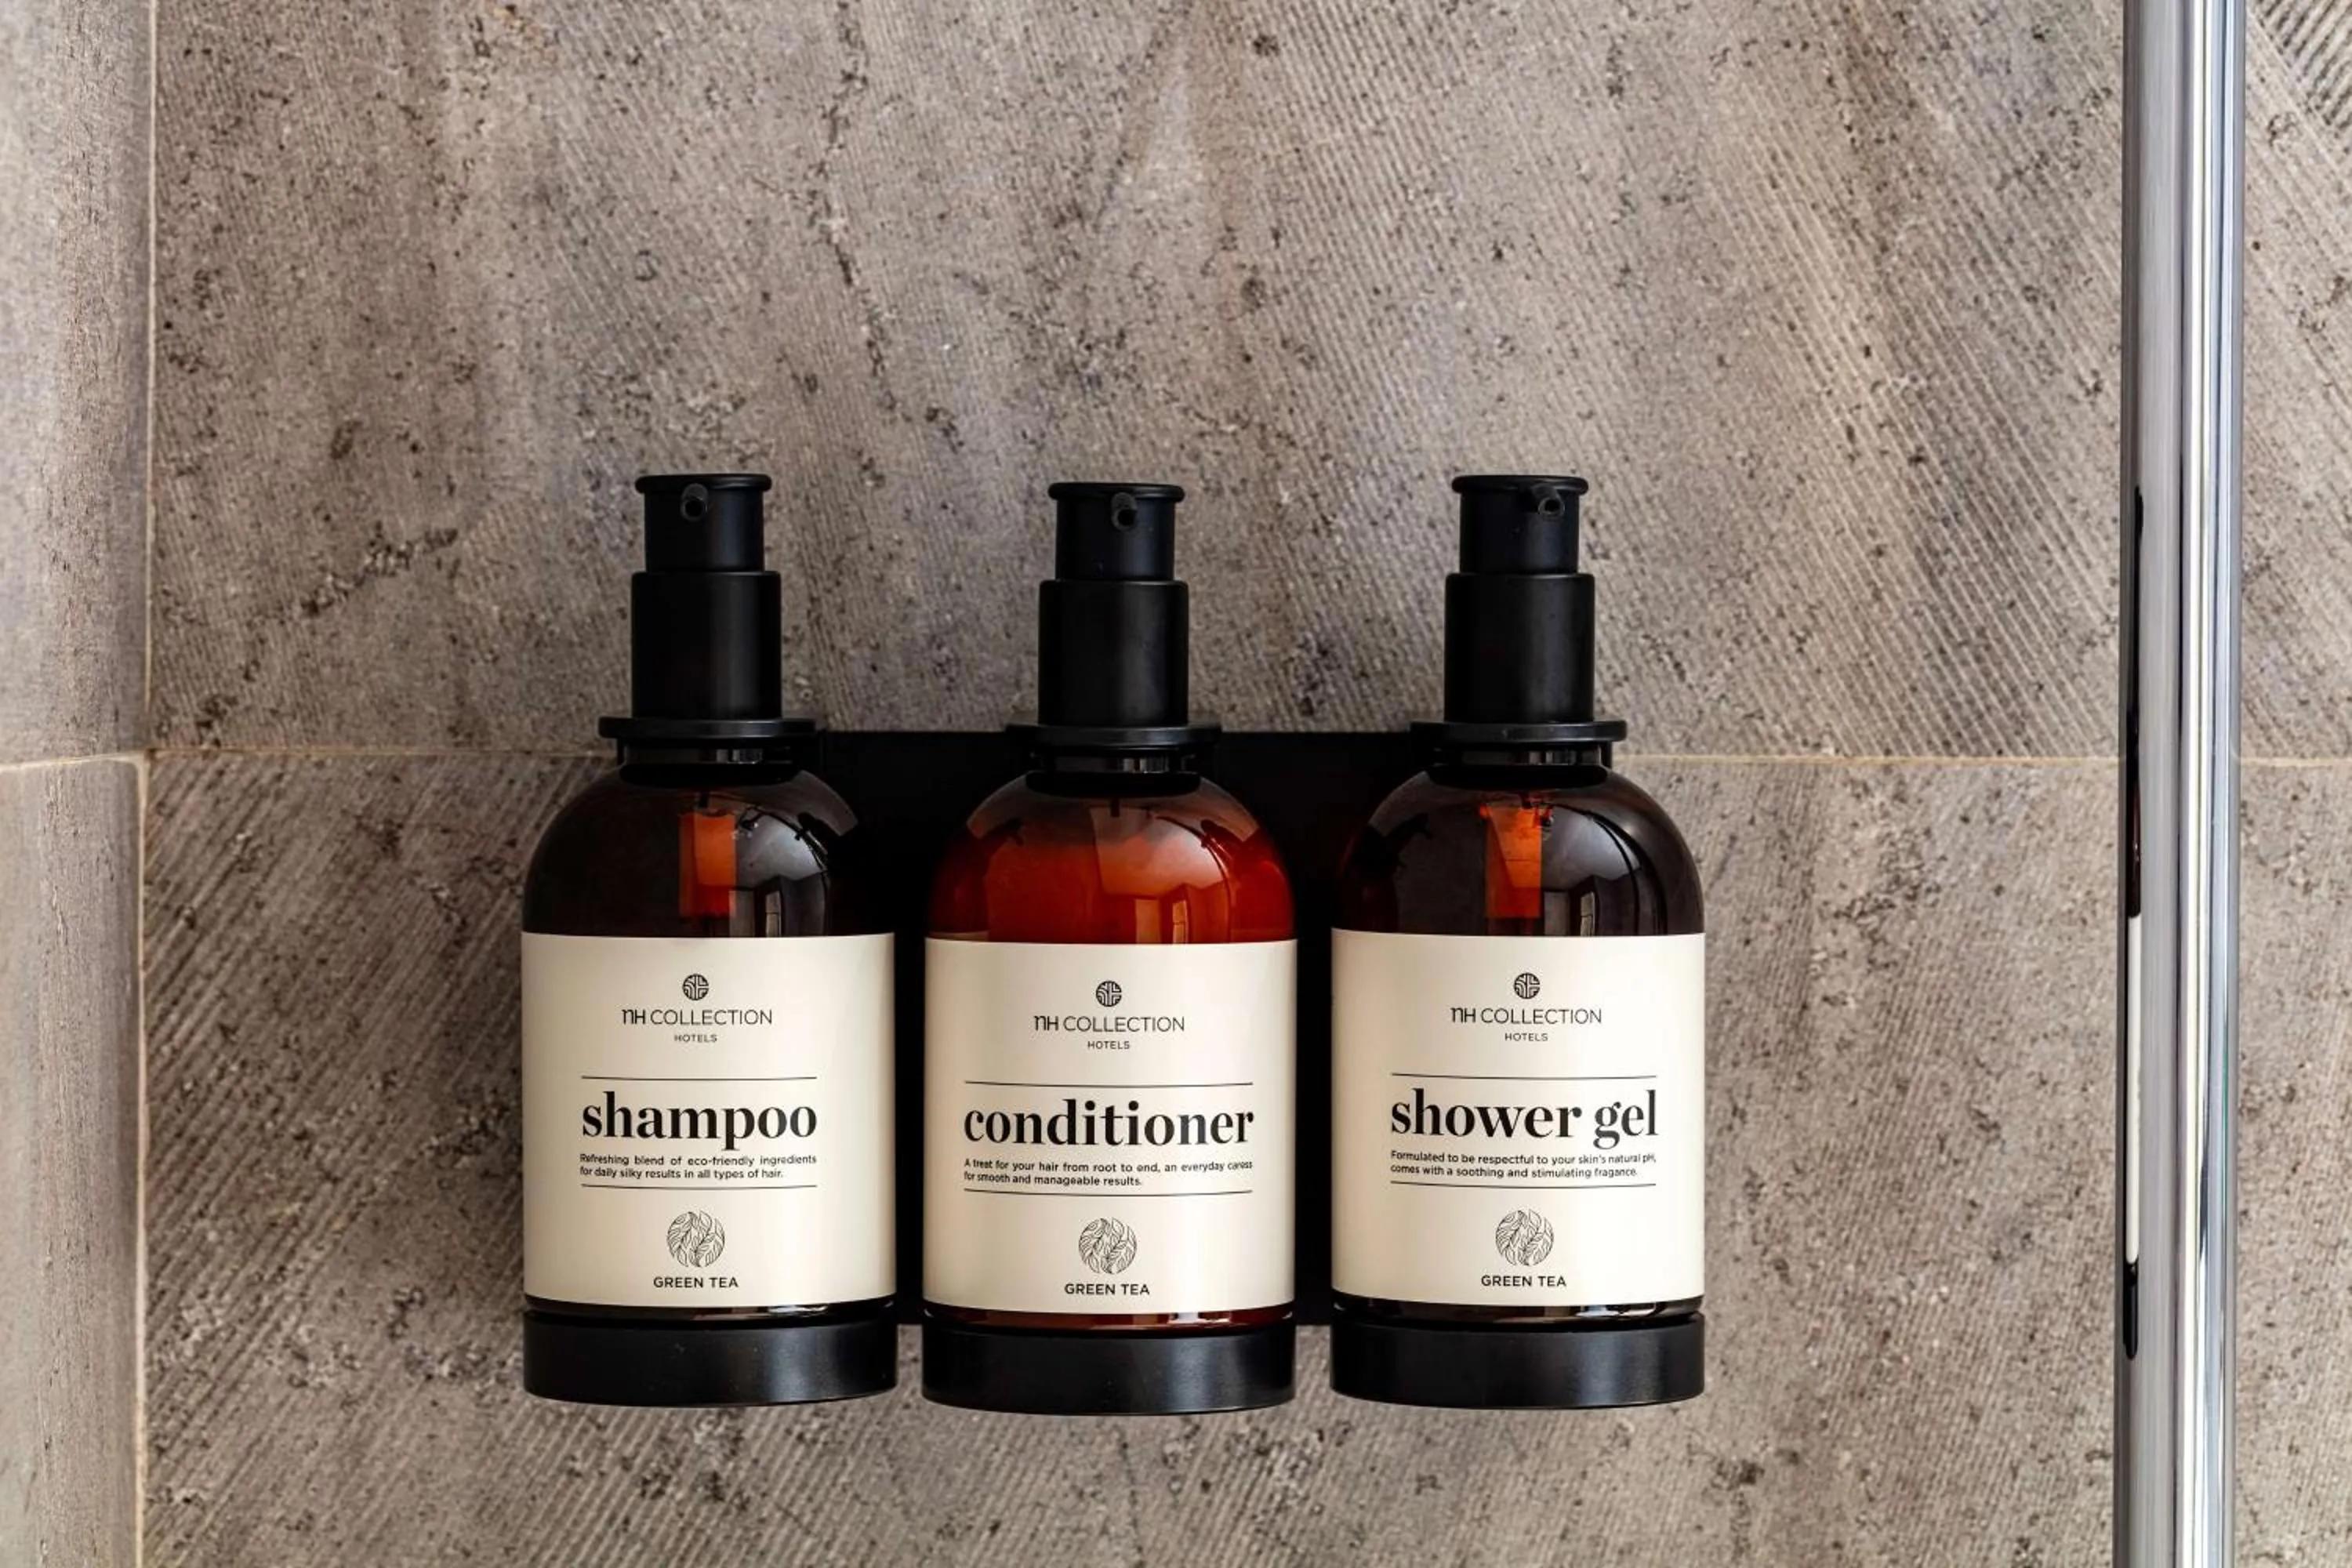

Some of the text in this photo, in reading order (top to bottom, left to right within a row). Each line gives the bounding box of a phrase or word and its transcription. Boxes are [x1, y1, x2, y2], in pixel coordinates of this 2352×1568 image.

[650, 1009, 772, 1025] COLLECTION
[1480, 1007, 1602, 1025] COLLECTION
[1063, 1015, 1185, 1033] COLLECTION
[673, 1033, 718, 1043] HOTELS
[1087, 1040, 1131, 1050] HOTELS
[1504, 1033, 1548, 1042] HOTELS
[582, 1091, 818, 1152] shampoo
[964, 1098, 1254, 1147] conditioner
[1391, 1087, 1658, 1150] shower gel
[579, 1153, 817, 1167] Refreshing blend of eco-friendly ingredients
[964, 1157, 1253, 1173] A treat for your hair from root to end, an everyday caress
[1390, 1150, 1445, 1162] Formulated
[1447, 1154, 1459, 1163] to
[1461, 1153, 1475, 1163] be
[1478, 1154, 1534, 1166] respectful
[1537, 1155, 1548, 1164] to
[1552, 1156, 1576, 1166] your
[1578, 1154, 1606, 1164] skin's
[1608, 1153, 1641, 1164] natural
[579, 1166, 784, 1180] for daily silky results in all types of hair.
[964, 1171, 1142, 1186] for smooth and manageable results.
[1390, 1164, 1420, 1174] comes
[1422, 1165, 1445, 1175] with
[1446, 1167, 1453, 1176] a
[1456, 1166, 1504, 1179] soothing
[1508, 1167, 1528, 1178] and
[1531, 1167, 1592, 1179] stimulating
[653, 1276, 739, 1289] GREEN TEA
[1481, 1275, 1567, 1287] GREEN TEA
[1064, 1283, 1150, 1295] GREEN TEA
